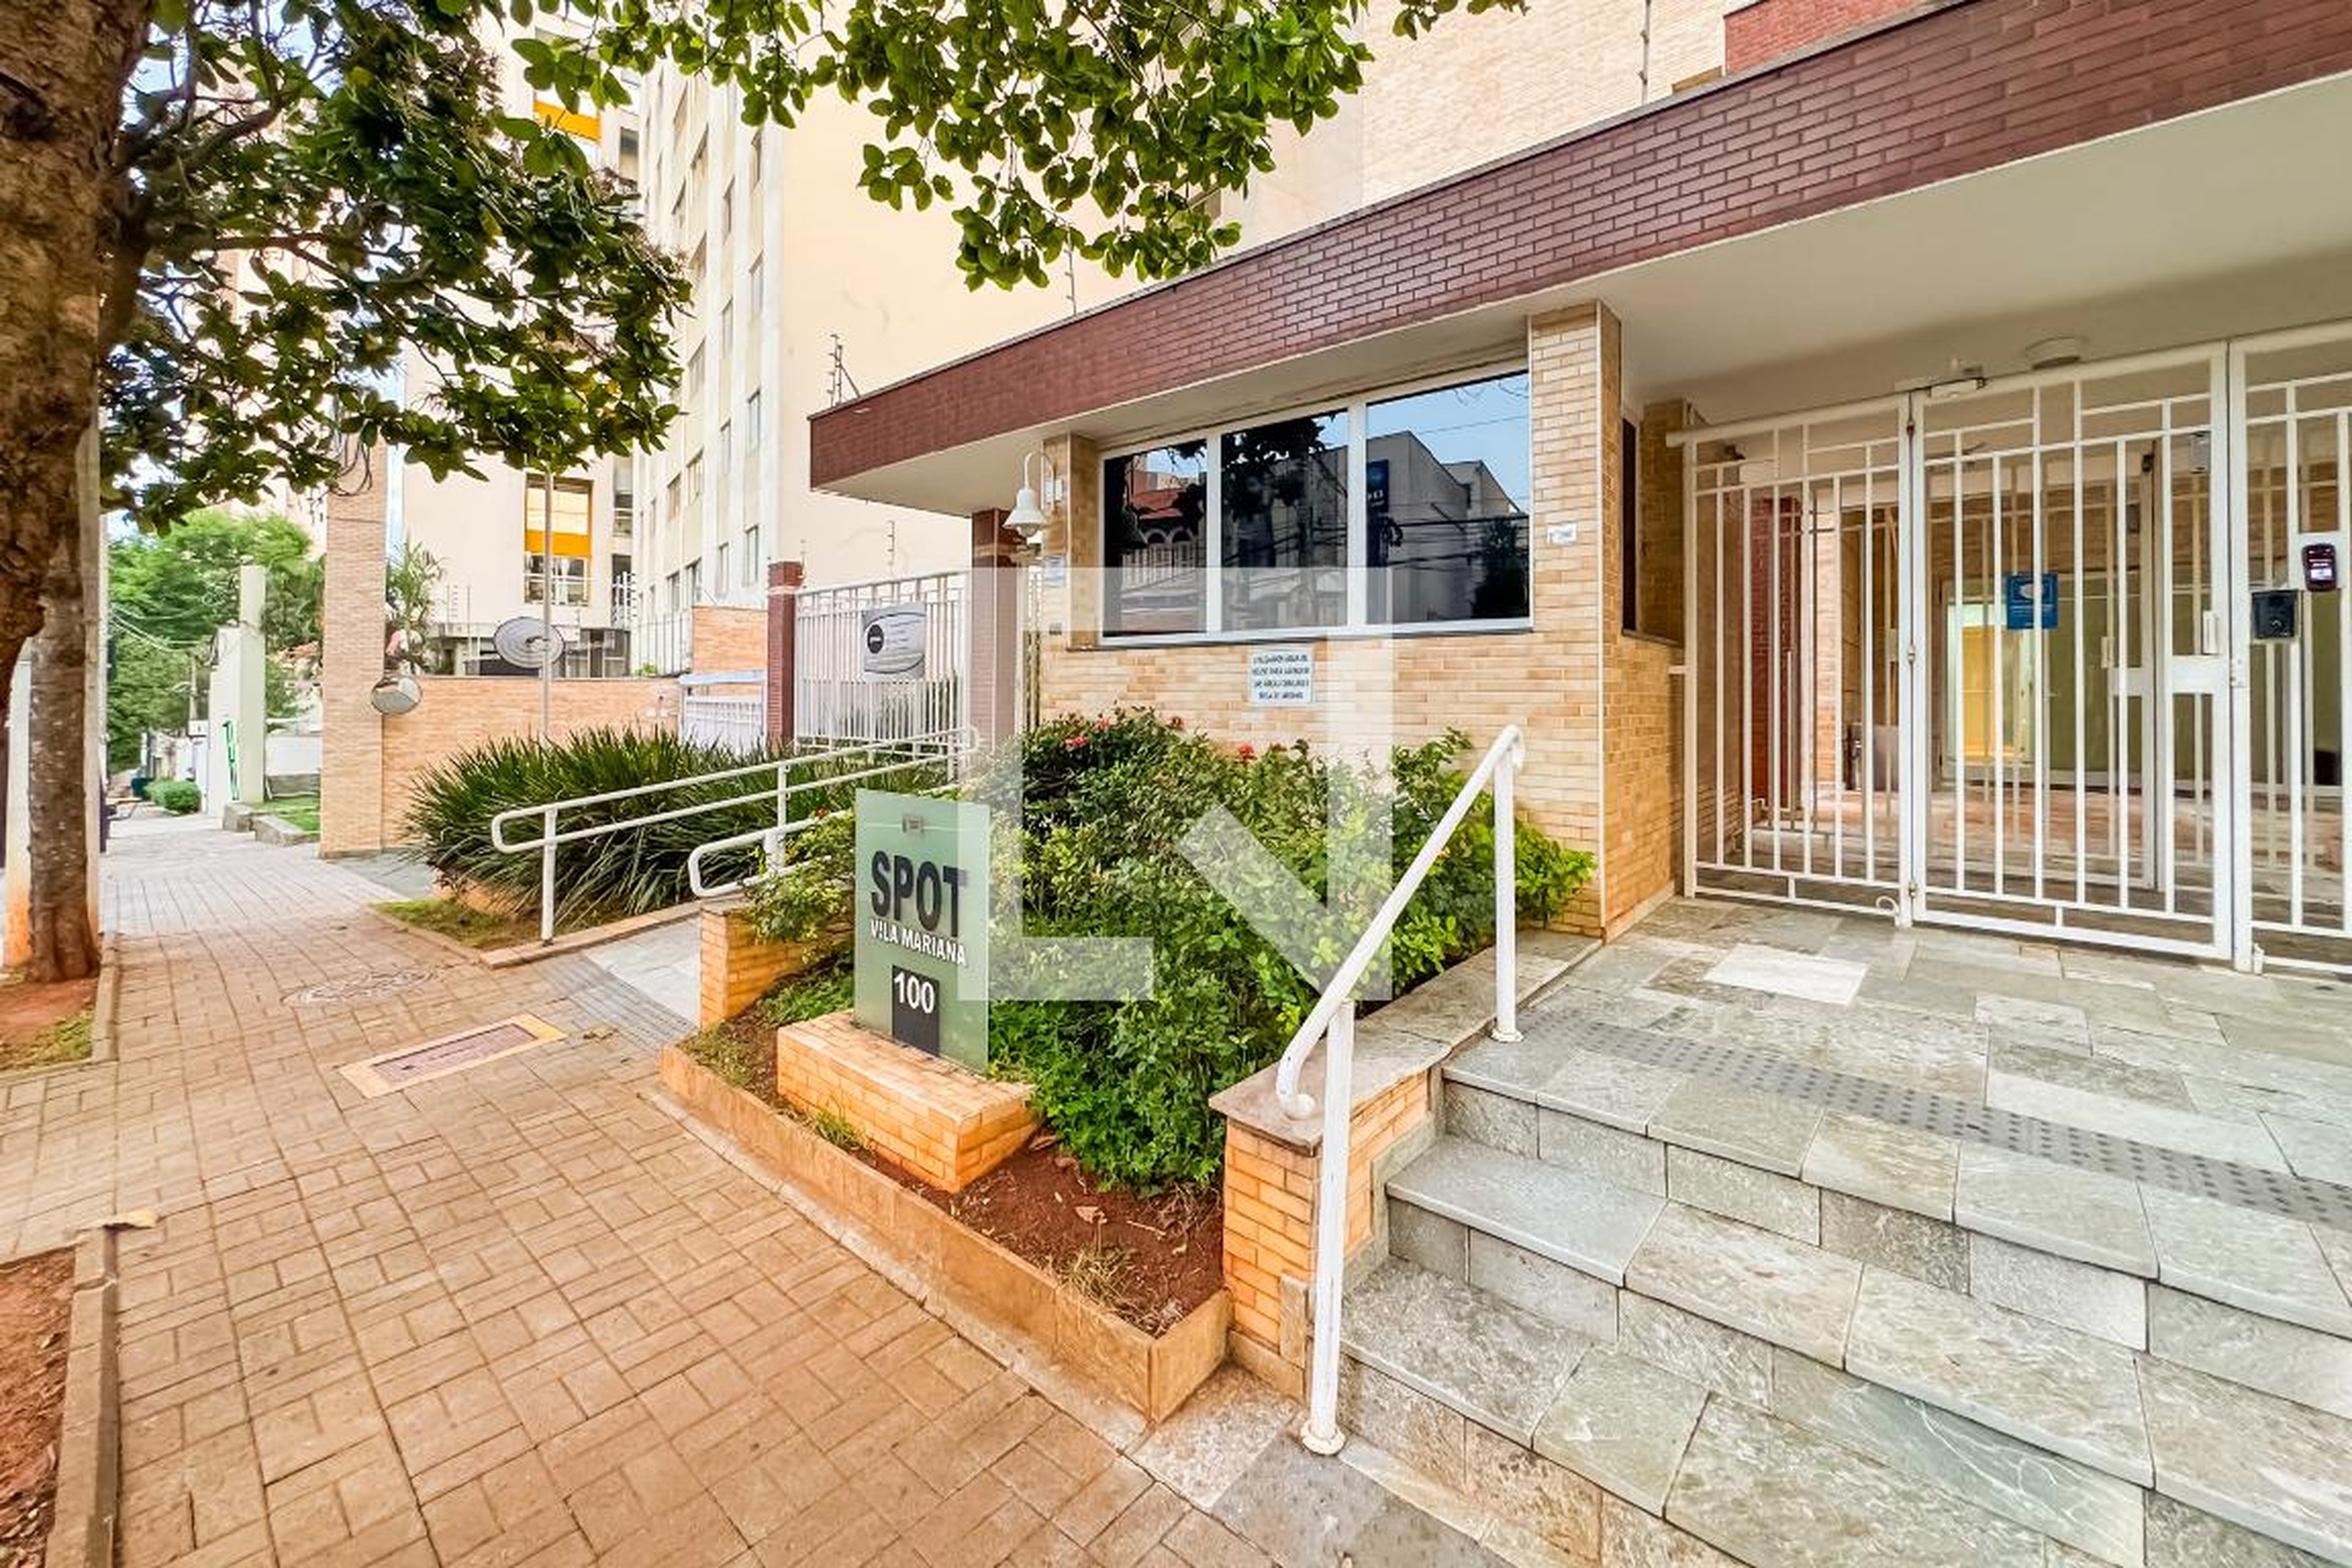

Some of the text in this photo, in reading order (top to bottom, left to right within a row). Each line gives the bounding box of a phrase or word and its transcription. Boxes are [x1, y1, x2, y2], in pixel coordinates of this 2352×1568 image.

[872, 851, 968, 938] SPOT
[871, 919, 967, 966] VILA MARIANA
[894, 971, 935, 1014] 100
